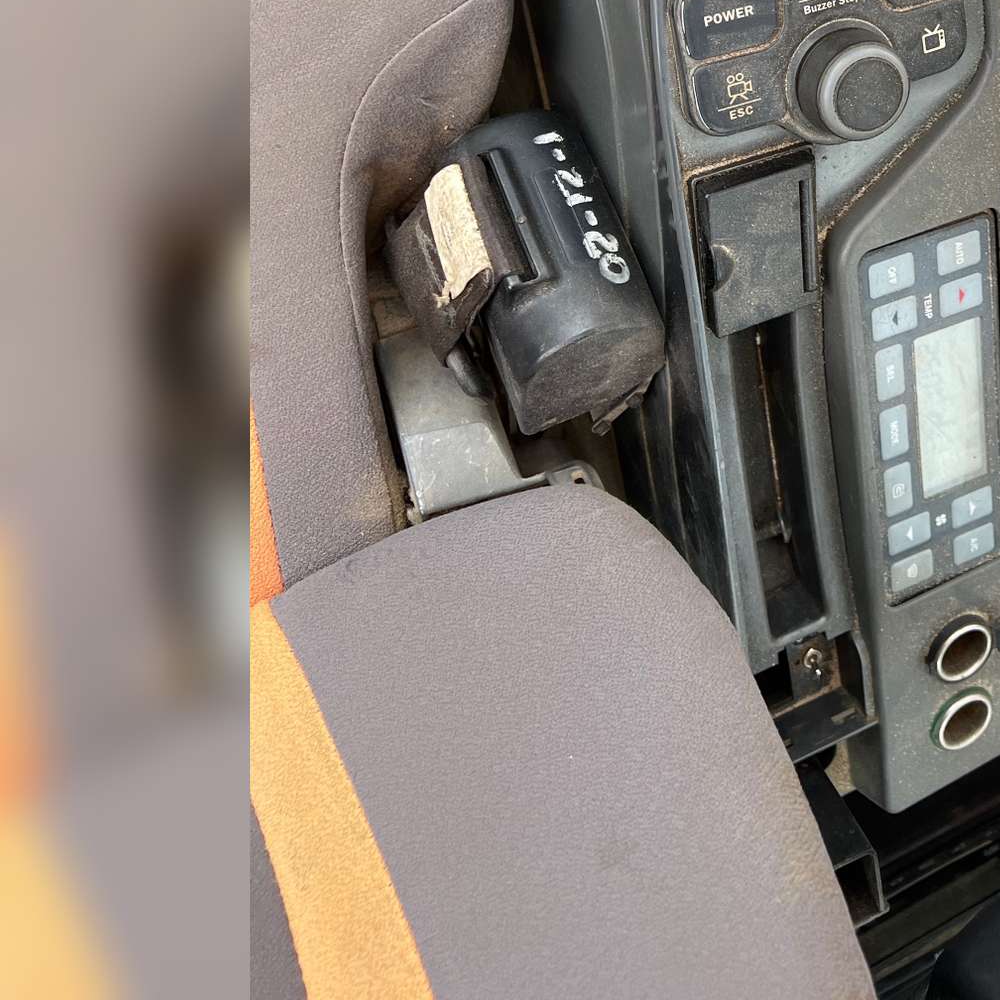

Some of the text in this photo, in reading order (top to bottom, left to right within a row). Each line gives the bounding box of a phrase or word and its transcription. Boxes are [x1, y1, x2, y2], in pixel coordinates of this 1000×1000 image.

[703, 4, 755, 27] POWER
[728, 105, 755, 121] ESC
[955, 241, 966, 265] AUTO
[923, 293, 933, 319] TEMP
